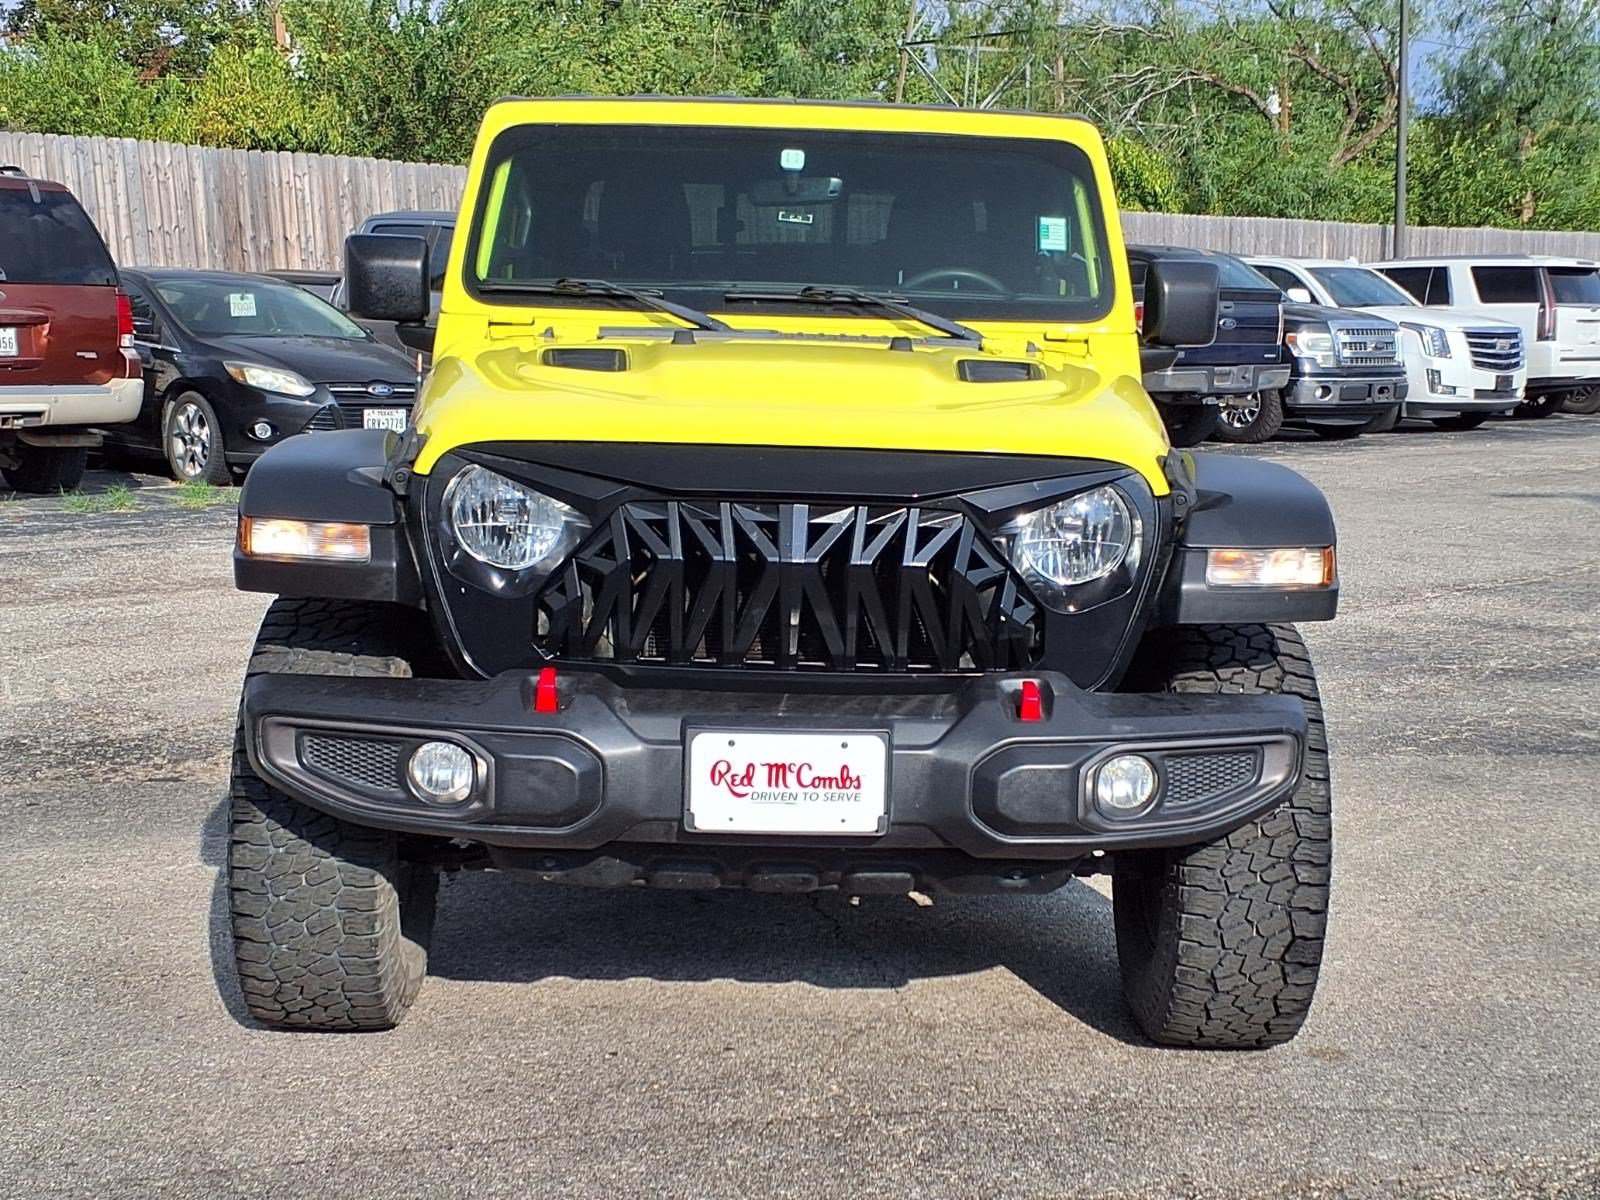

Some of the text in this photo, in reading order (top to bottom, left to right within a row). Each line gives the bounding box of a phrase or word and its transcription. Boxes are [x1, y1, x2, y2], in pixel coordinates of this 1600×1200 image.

[710, 759, 862, 798] Red McCombs
[750, 791, 862, 802] DRIVEN TO SERVE
